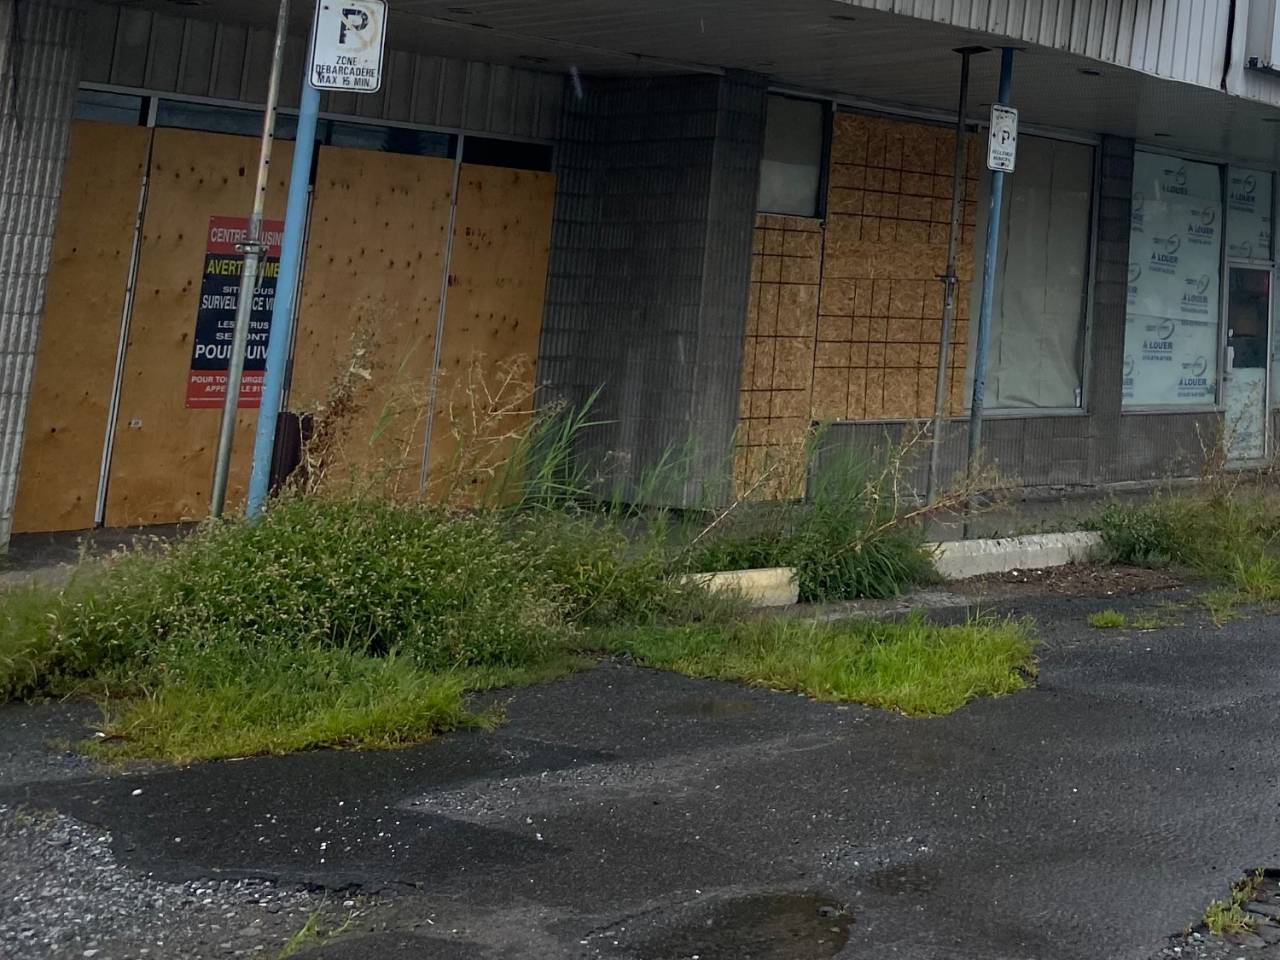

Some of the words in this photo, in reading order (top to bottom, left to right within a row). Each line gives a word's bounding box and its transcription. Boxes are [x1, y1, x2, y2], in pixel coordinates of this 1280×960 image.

[339, 8, 368, 44] P
[336, 56, 357, 66] ZONE
[210, 227, 248, 243] CENTRE
[1149, 342, 1173, 350] LOUER
[1185, 378, 1207, 386] LOUER
